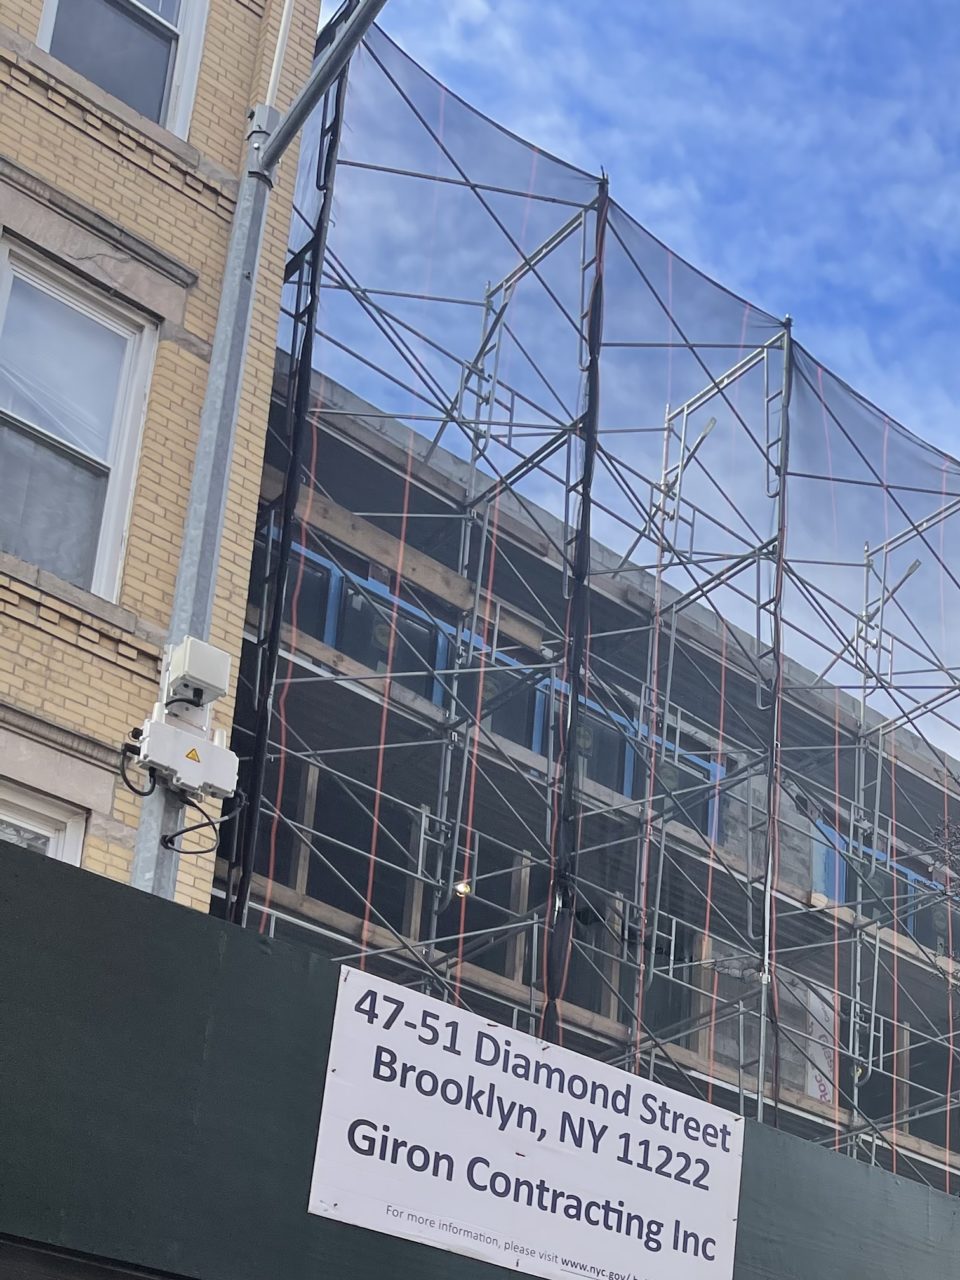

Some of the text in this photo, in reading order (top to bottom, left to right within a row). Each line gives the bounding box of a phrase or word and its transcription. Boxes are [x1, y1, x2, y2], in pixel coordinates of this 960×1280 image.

[354, 989, 732, 1153] 47-51 Diamond Street
[372, 1045, 711, 1192] Brooklyn, NY 11222
[347, 1118, 717, 1262] Giron Contracting Inc
[386, 1204, 404, 1219] For
[407, 1211, 436, 1229] more
[438, 1219, 501, 1250] information,
[503, 1240, 537, 1258] please
[538, 1248, 559, 1265] visit
